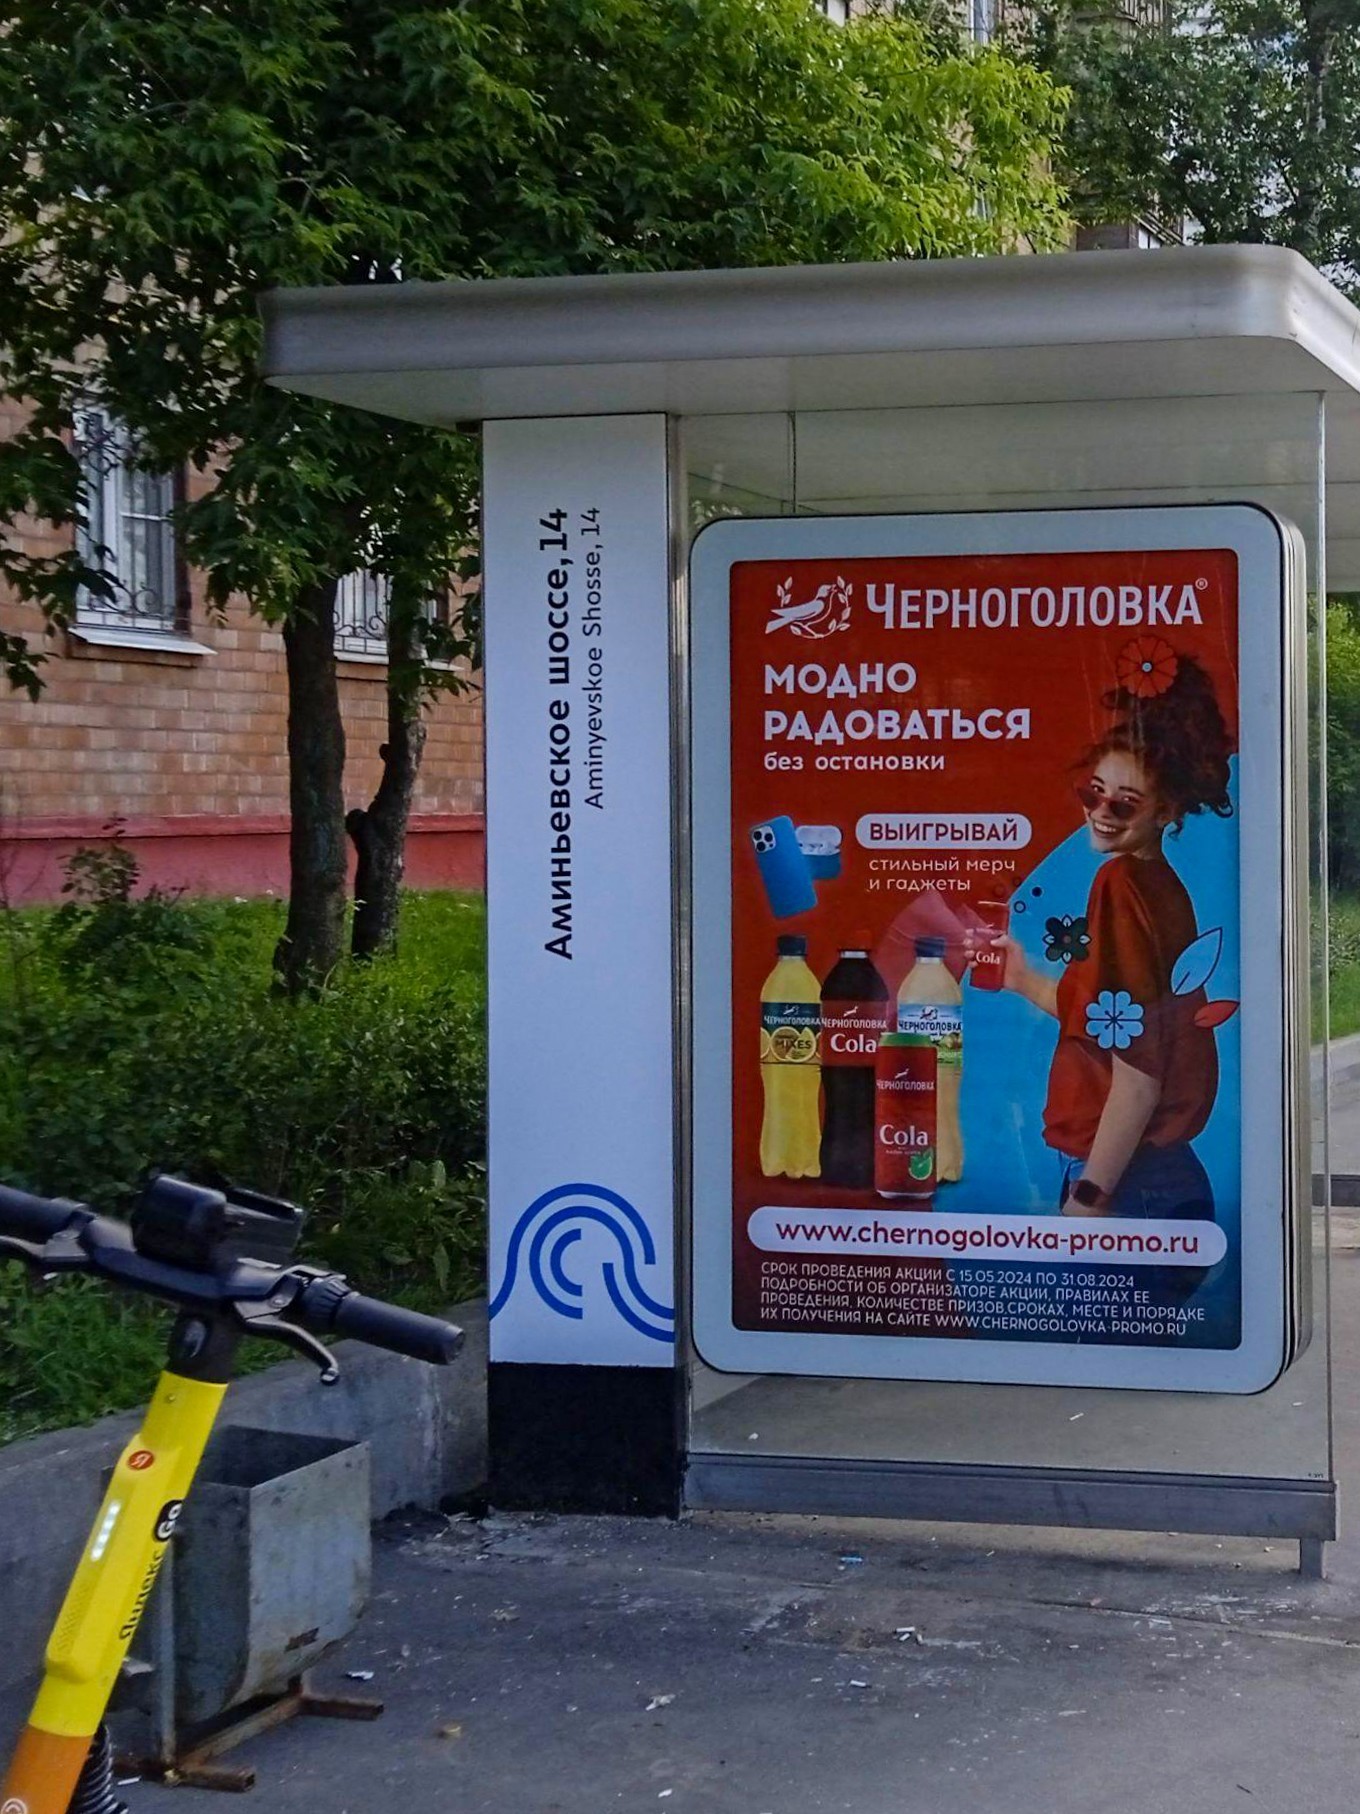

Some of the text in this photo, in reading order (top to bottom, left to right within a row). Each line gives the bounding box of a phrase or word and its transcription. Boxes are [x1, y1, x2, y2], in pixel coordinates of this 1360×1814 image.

[580, 507, 607, 810] Aminyevskoe Shosse, 14
[764, 662, 917, 699] МОДНО
[764, 708, 1031, 746] РАДОВАТЬСЯ
[764, 752, 945, 771] без остановки
[543, 699, 572, 960] Аминьевское
[869, 817, 1018, 844] ВЫИГРЫВАЙ
[869, 856, 1015, 874] стильный мерч
[869, 878, 971, 893] и гаджеты
[821, 1018, 888, 1029] ЧЕРНОГОЛОВКА
[899, 1020, 962, 1031] ЧЕРНОГОЛОВКА
[830, 1033, 877, 1053] Cola
[880, 1124, 929, 1146] Cola
[776, 1220, 1199, 1255] www.chernogolovka-promo.ru
[761, 1262, 798, 1275] СРОК
[802, 1263, 891, 1280] ПРОВЕДЕНИЯ
[896, 1267, 942, 1281] АКЦИИ
[1036, 1272, 1056, 1284] ПО
[1061, 1273, 1135, 1288] 31.08.2024
[761, 1277, 1150, 1304] ПОДРОБНОСТИ ОБ ОРГАНИЗАТОРЕ АКЦИИ, ПРАВИЛАХ ЕЕ
[761, 1307, 1187, 1336] ИХ ПОЛУЧЕНИЯ НА САЙТЕ WWW.CHERNOGOLOVKA-PROMO.RU
[857, 1296, 944, 1312] КОЛИЧЕСТВЕ
[1072, 1304, 1119, 1318] МЕСТЕ
[1122, 1306, 1133, 1318] И
[1137, 1306, 1205, 1322] ПОРЯДКЕ
[157, 1503, 183, 1539] Go
